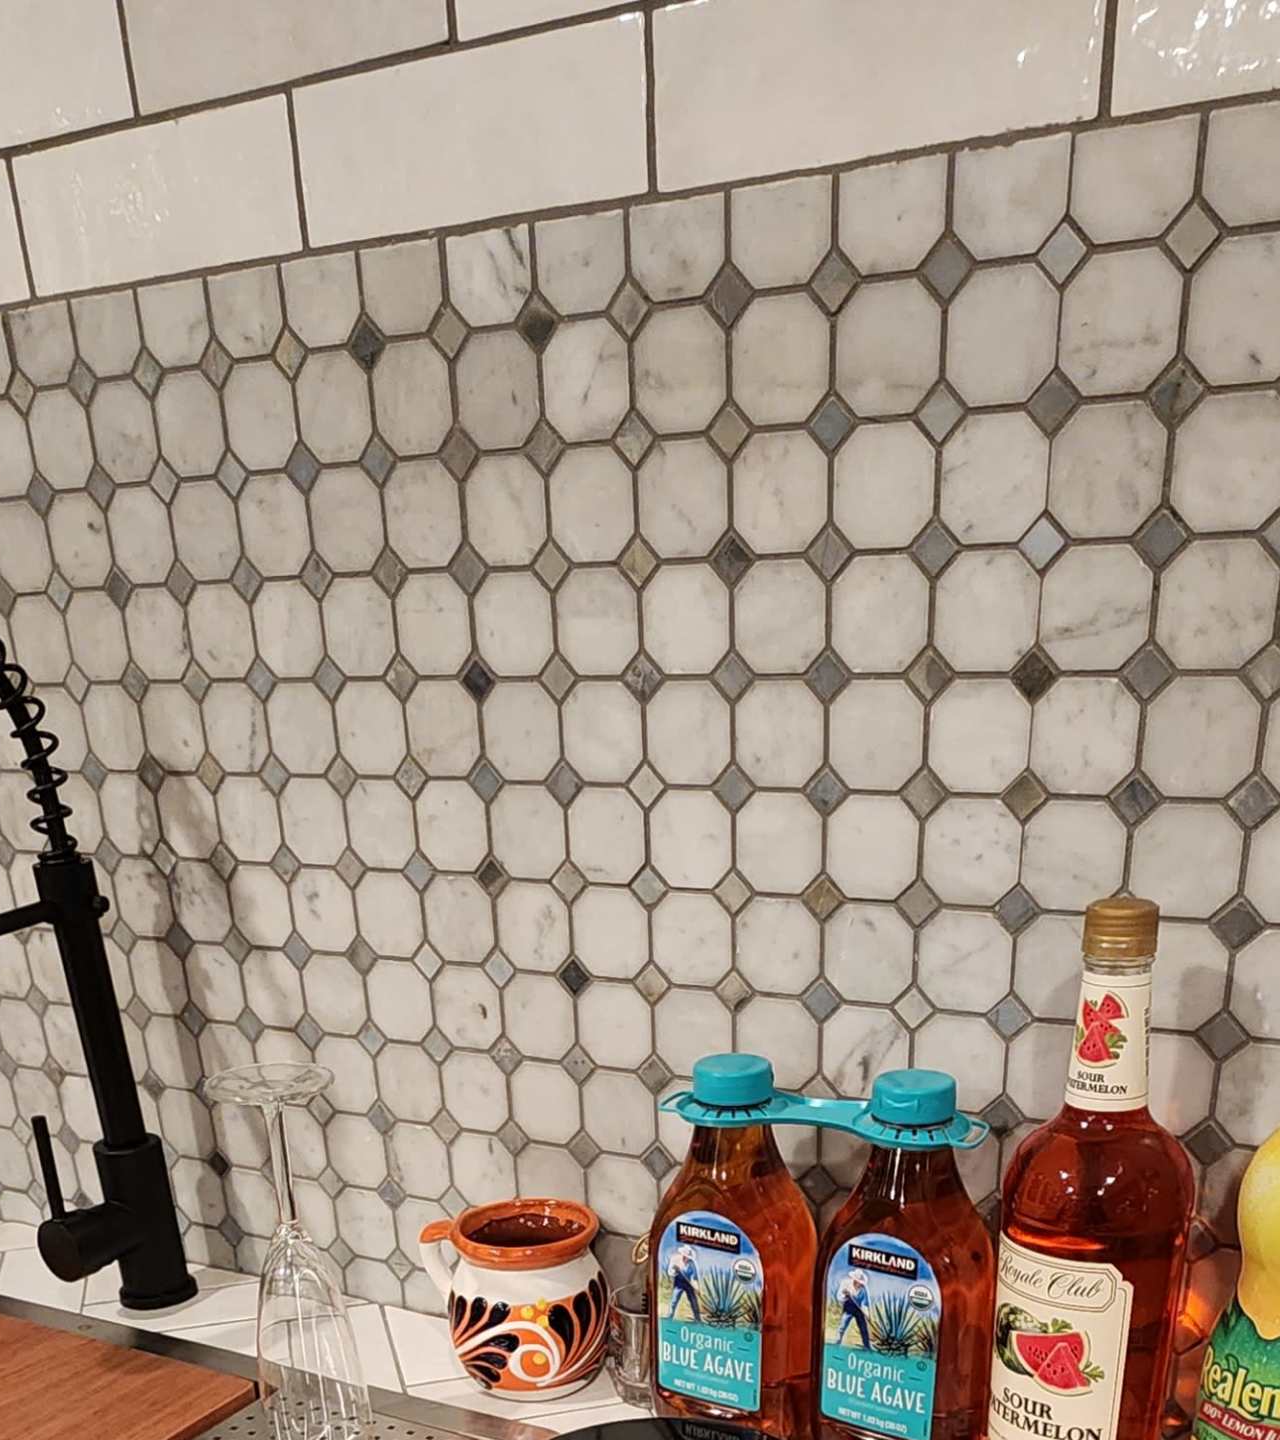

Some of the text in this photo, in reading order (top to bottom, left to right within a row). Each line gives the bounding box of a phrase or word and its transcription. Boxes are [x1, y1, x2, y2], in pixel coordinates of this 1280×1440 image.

[1077, 1069, 1105, 1083] SOUR
[679, 1224, 739, 1246] KIRKLAND
[851, 1247, 916, 1271] KIRKLAND
[1000, 1249, 1106, 1299] Royale Club
[680, 1326, 736, 1354] Organic
[662, 1340, 700, 1371] BLUE
[703, 1351, 756, 1384] AGAVE
[848, 1352, 905, 1384] Organic
[826, 1367, 867, 1399] BLUE
[871, 1381, 926, 1414] AGAVE
[1003, 1386, 1054, 1421] SOUR
[1222, 1412, 1265, 1440] LEMON
